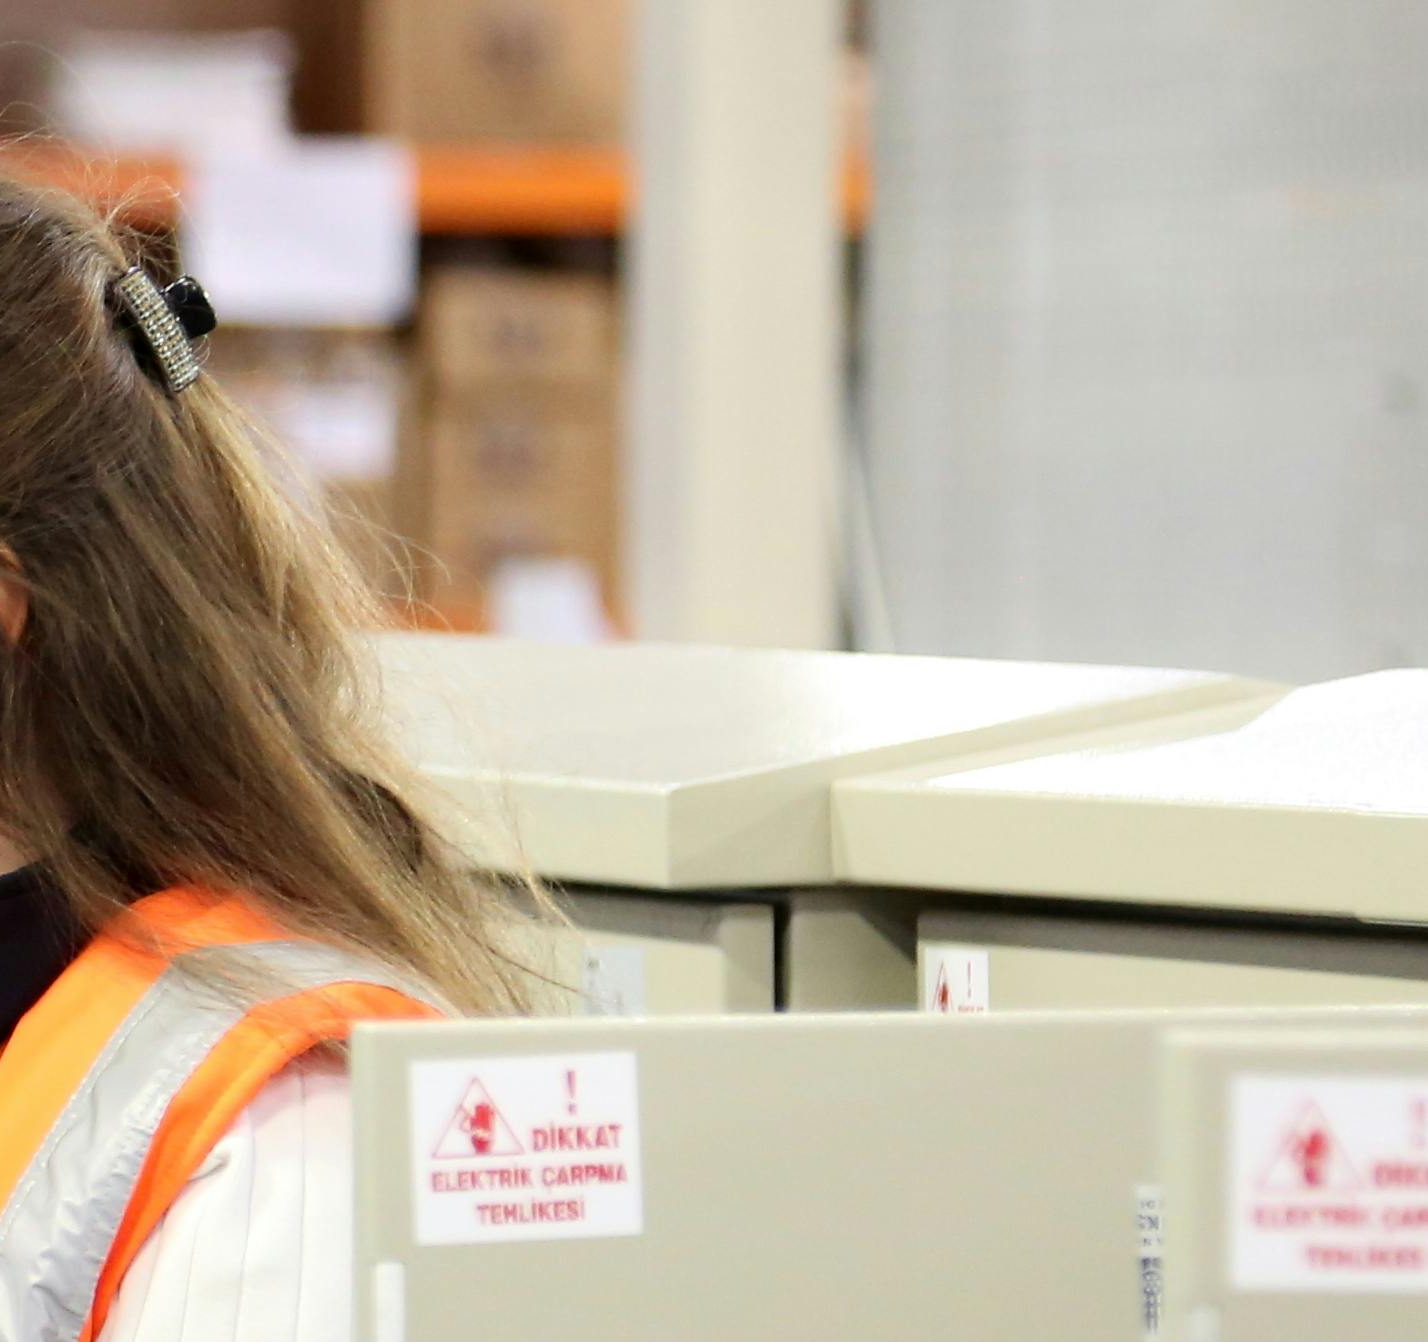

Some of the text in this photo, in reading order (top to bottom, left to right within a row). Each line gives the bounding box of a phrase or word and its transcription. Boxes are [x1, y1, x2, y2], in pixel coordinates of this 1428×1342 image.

[532, 1121, 623, 1153] DİKKAT
[431, 1162, 629, 1195] ELEKTRİK ÇARPMA
